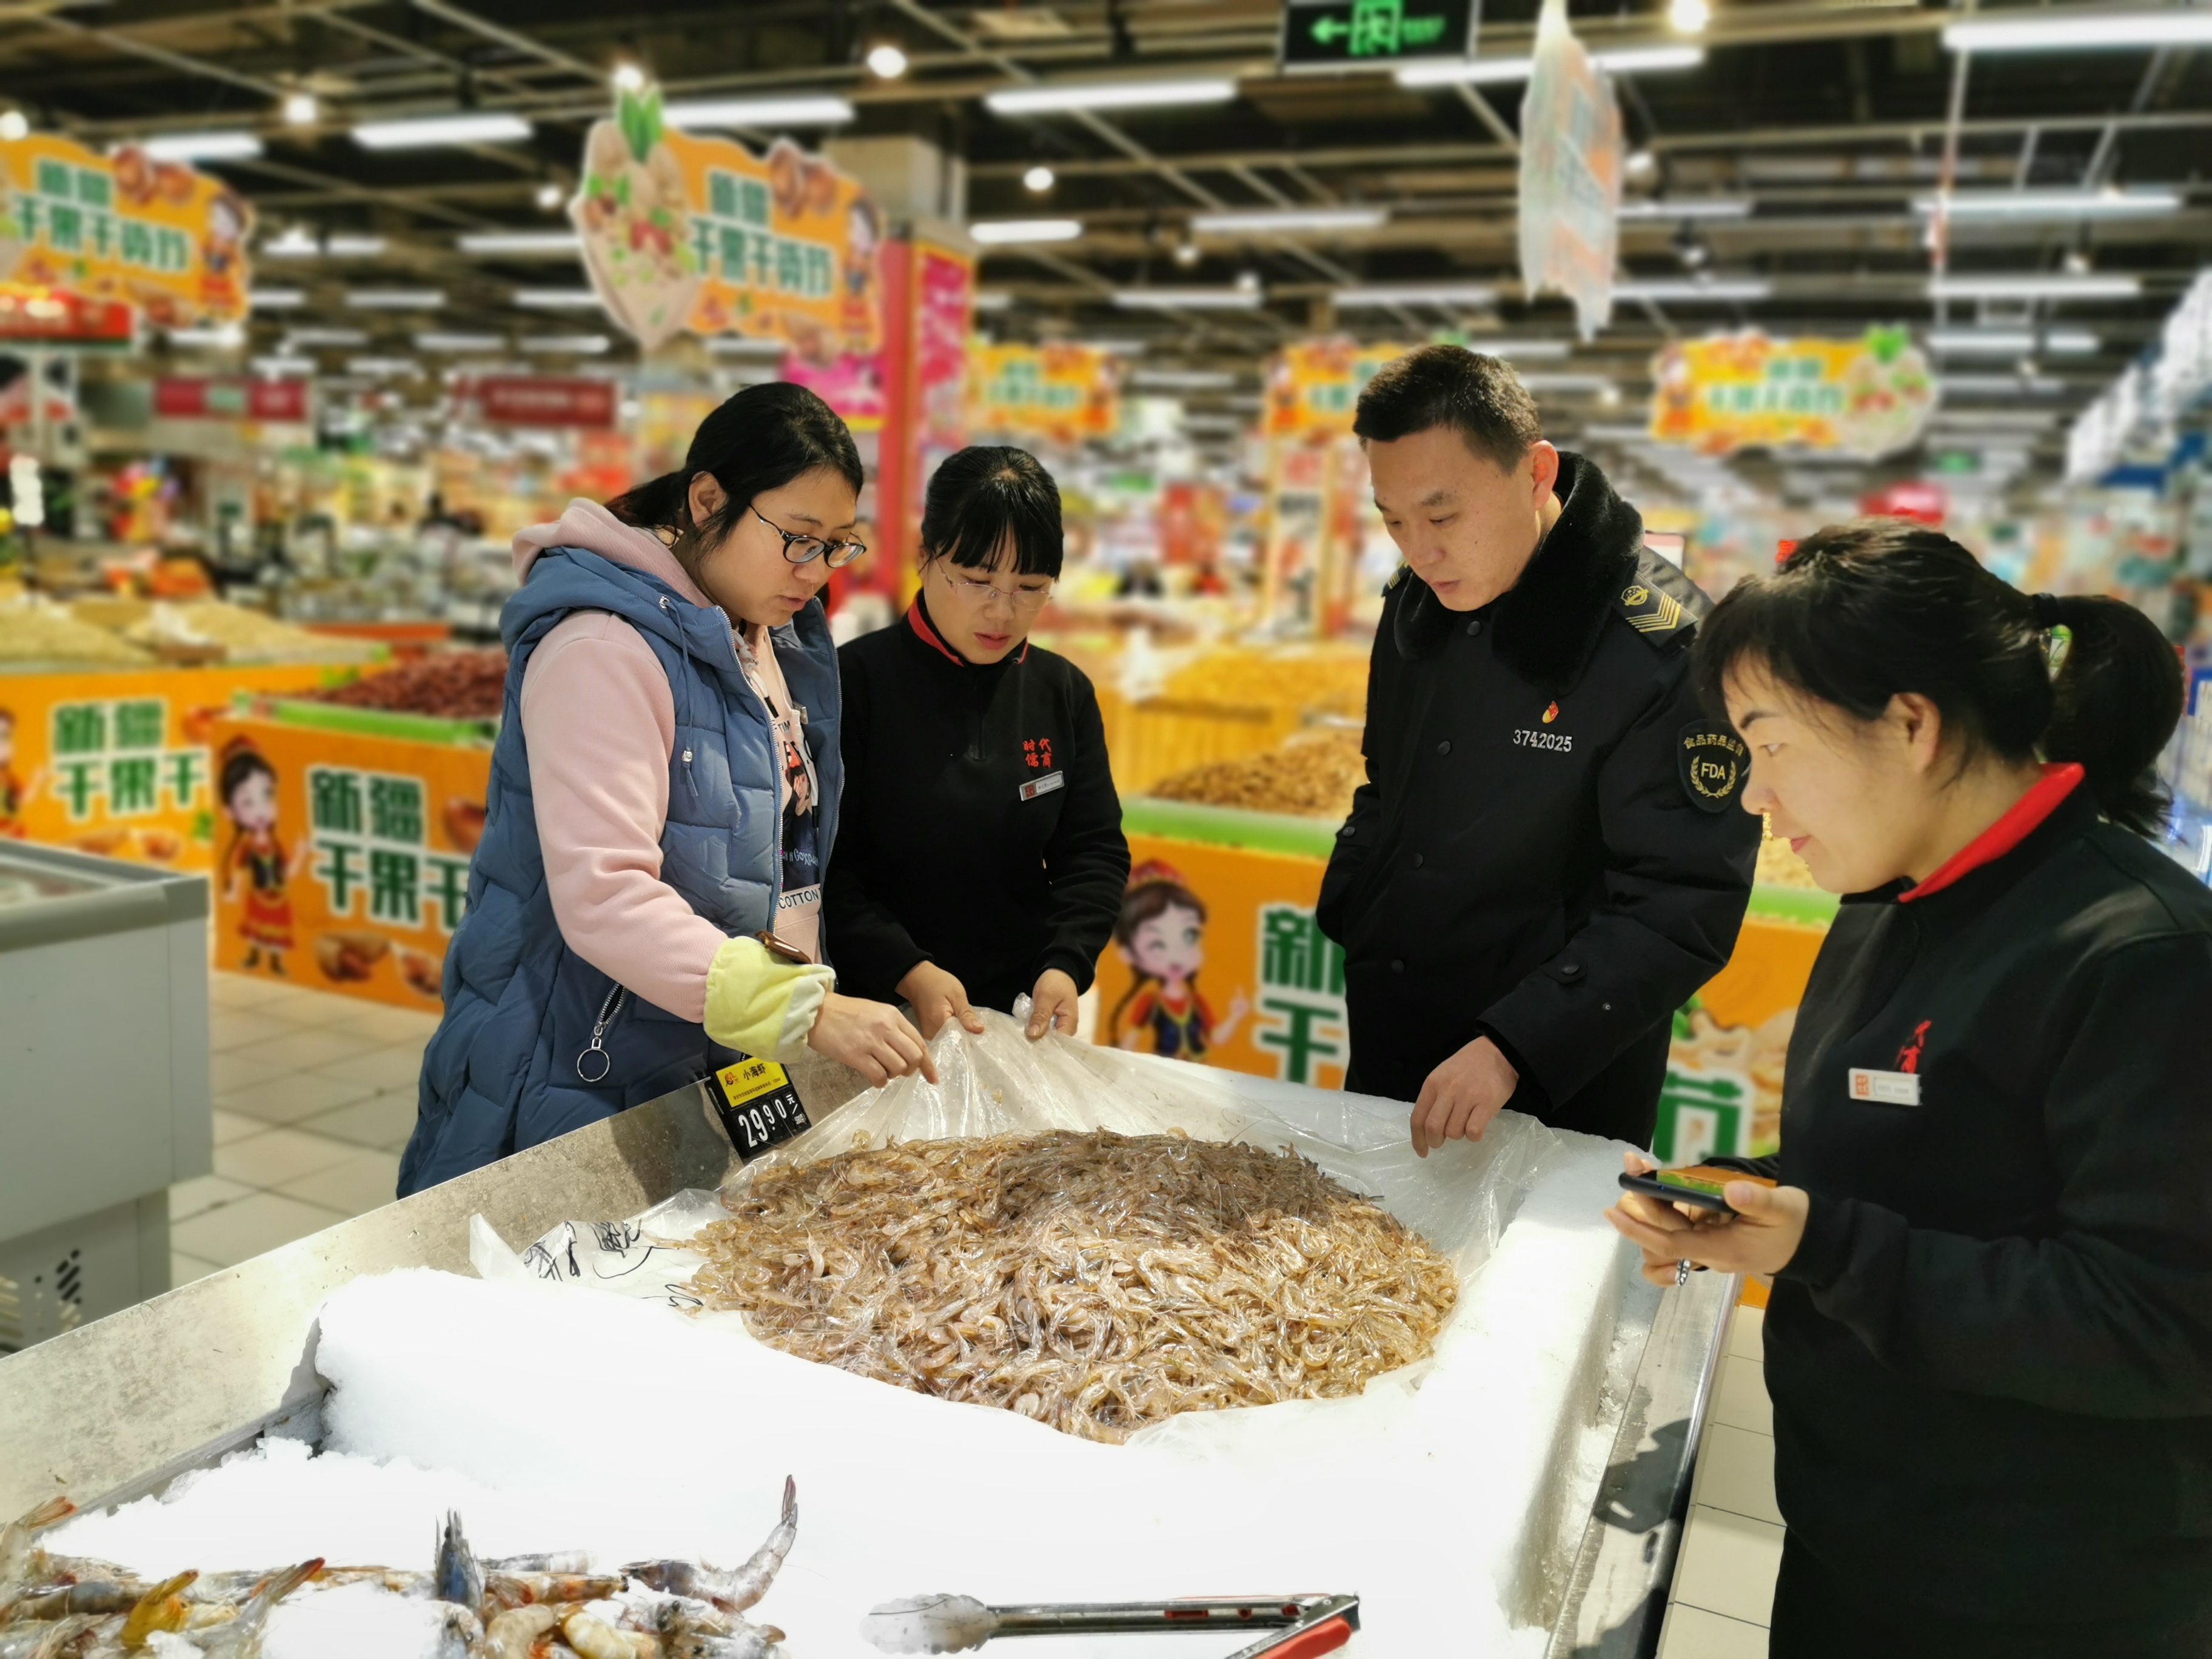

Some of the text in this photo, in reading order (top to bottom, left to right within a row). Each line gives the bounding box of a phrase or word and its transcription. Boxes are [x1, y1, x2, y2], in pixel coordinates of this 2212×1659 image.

[1023, 738, 1052, 752] 时代
[1513, 729, 1572, 752] 3742025
[1025, 751, 1052, 768] 儒商
[1700, 762, 1726, 780] FDA
[310, 767, 423, 844] 新疆
[779, 888, 820, 910] COTTON
[1262, 908, 1345, 996] 新
[1261, 997, 1341, 1084] 干
[743, 1062, 766, 1081] 小海虾
